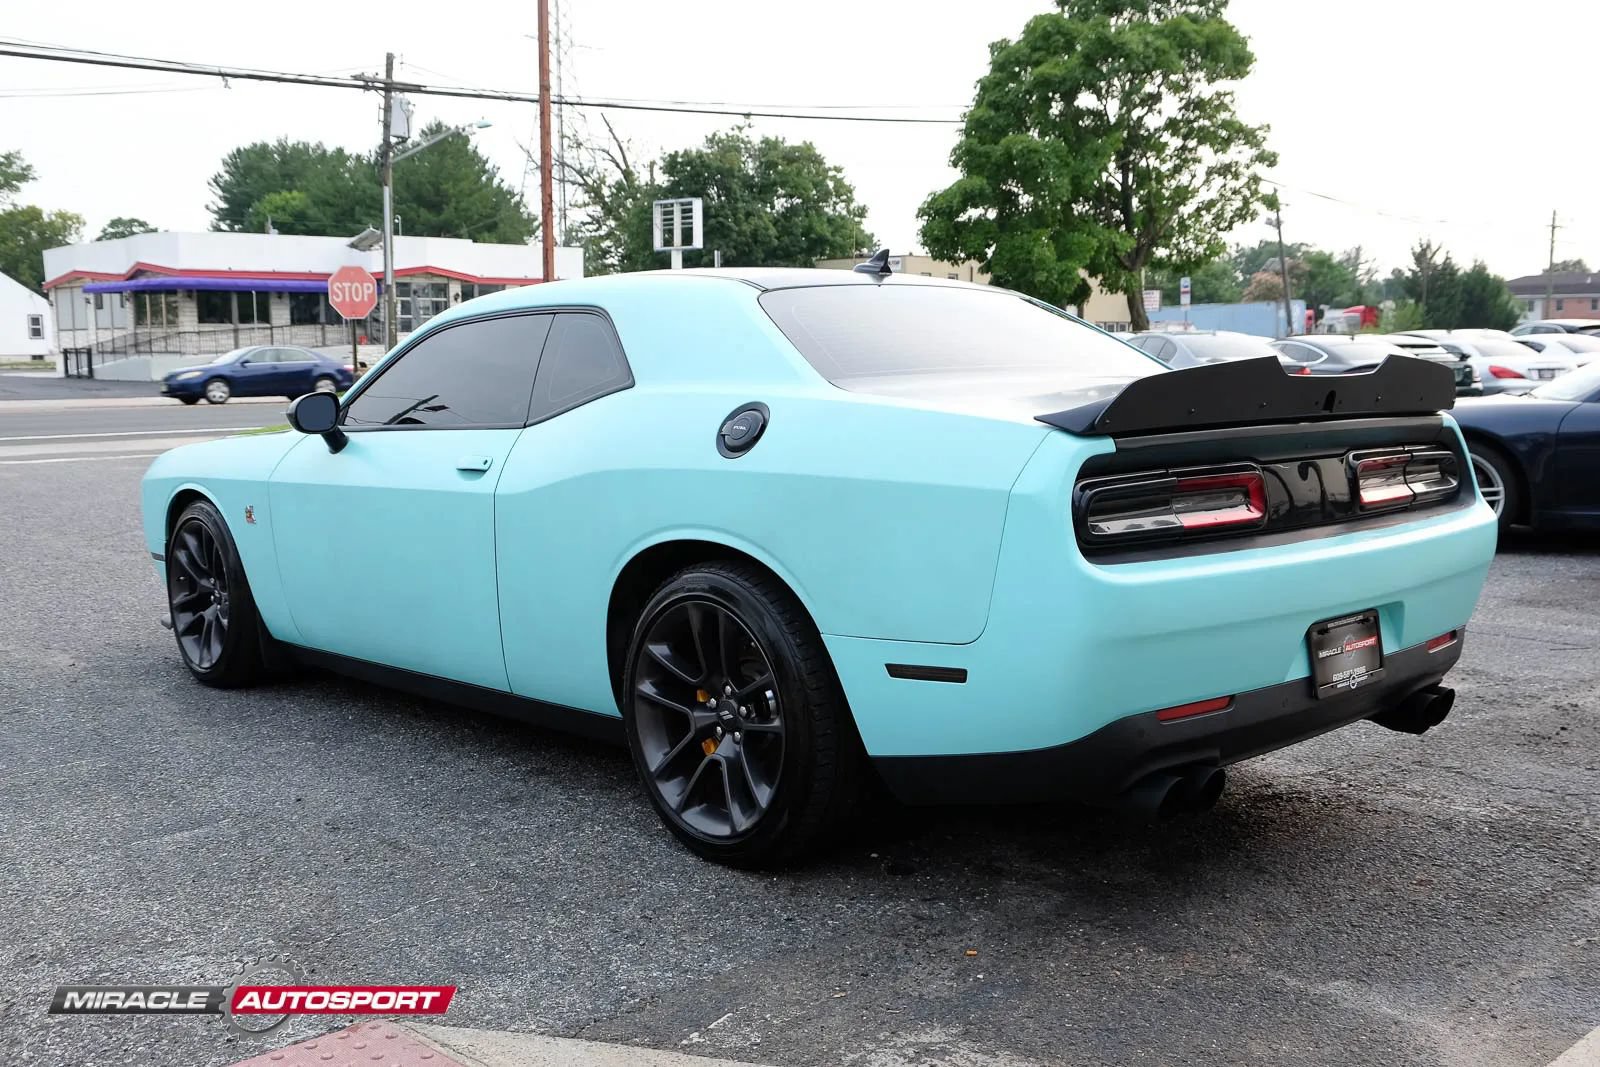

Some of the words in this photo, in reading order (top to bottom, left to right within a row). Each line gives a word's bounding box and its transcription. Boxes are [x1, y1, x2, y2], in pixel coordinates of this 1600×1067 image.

[332, 282, 374, 302] STOP
[1319, 646, 1342, 659] MIRACLE
[1345, 638, 1376, 652] AUTOSPORT
